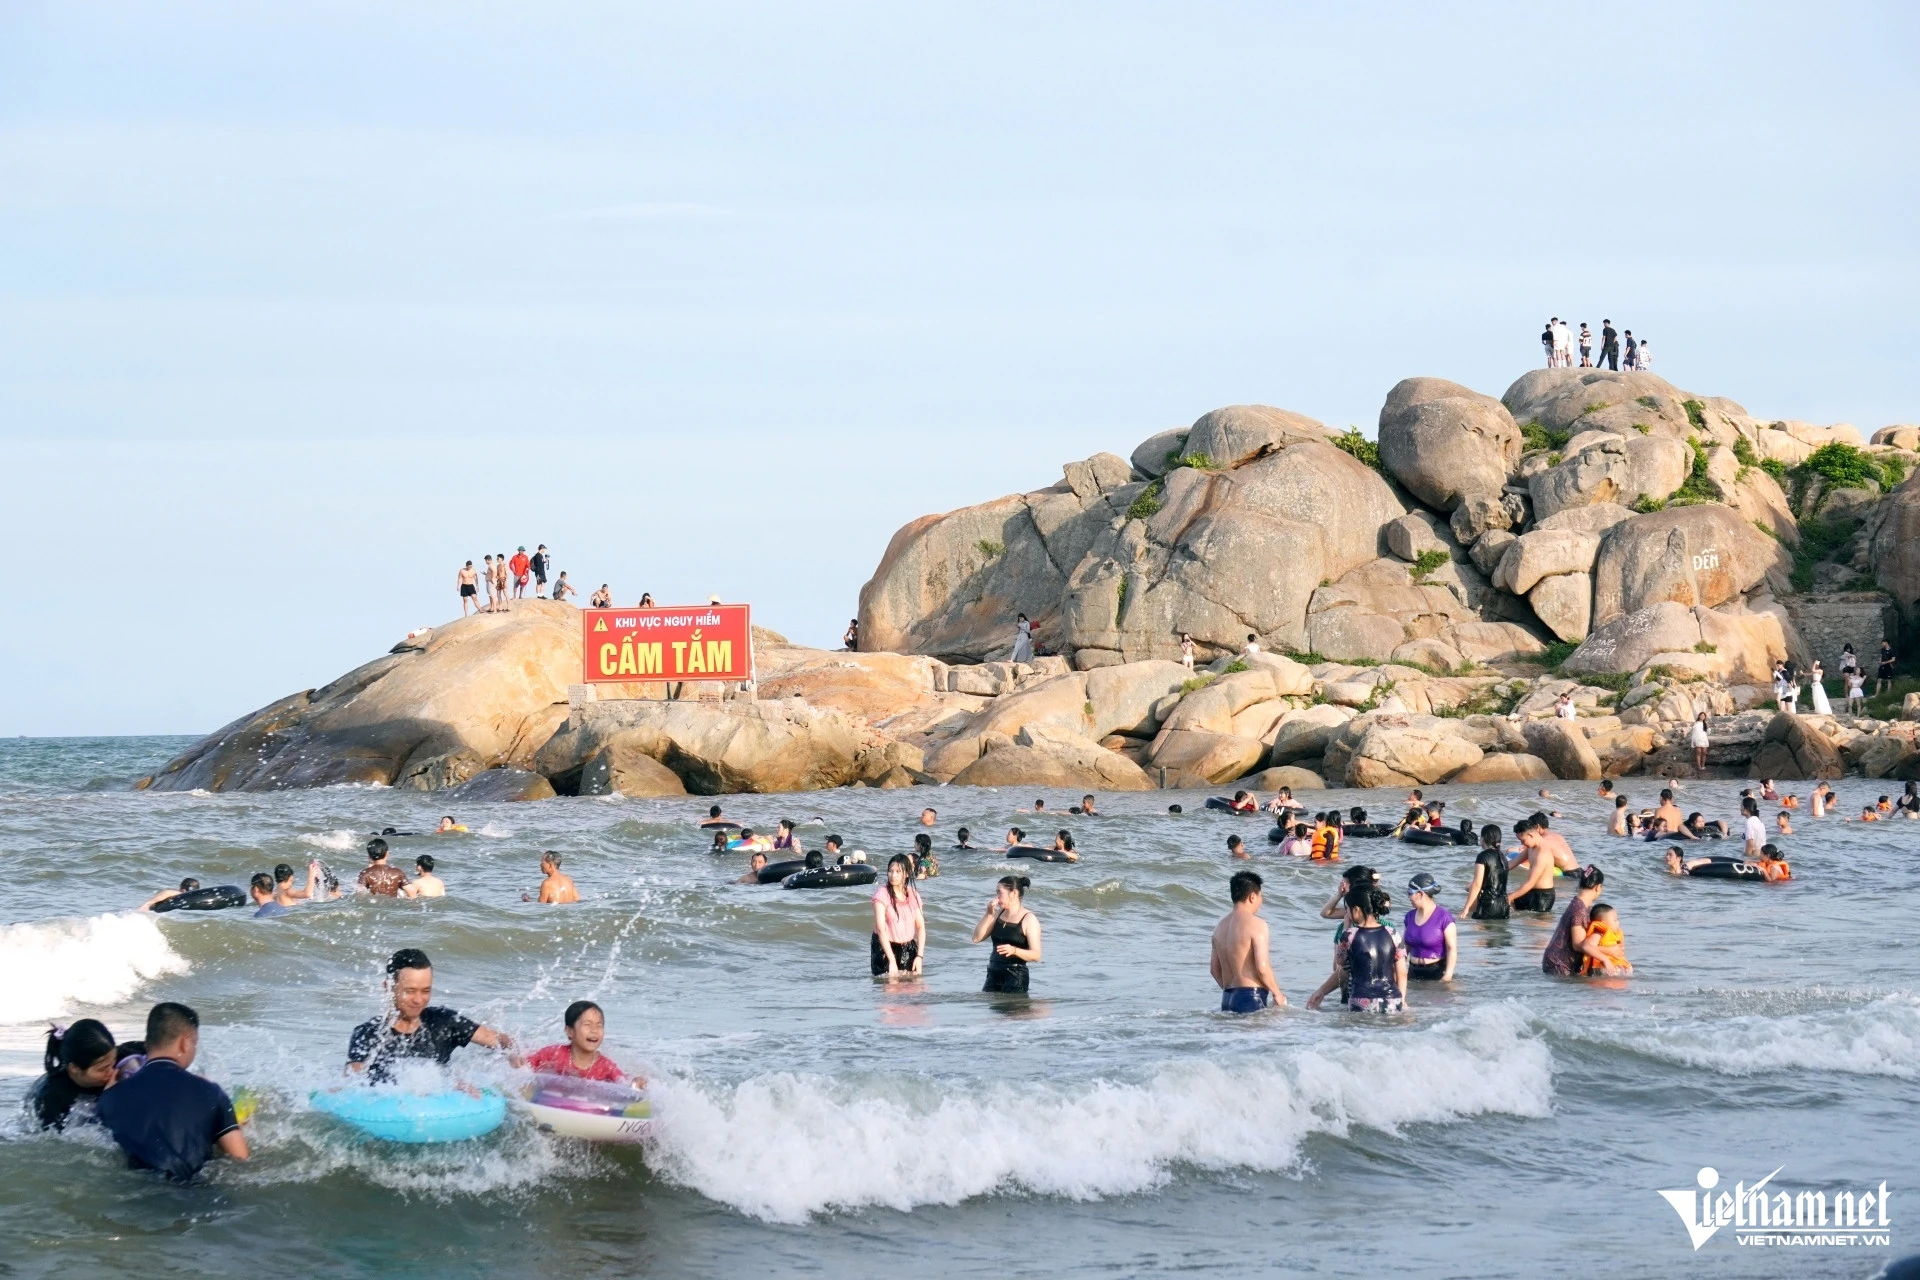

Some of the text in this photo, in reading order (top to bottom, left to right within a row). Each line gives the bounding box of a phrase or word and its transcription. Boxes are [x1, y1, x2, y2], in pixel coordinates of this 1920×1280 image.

[615, 609, 721, 630] KHU VỰC NGUY HIỂM
[600, 628, 732, 676] CẤM TẮM
